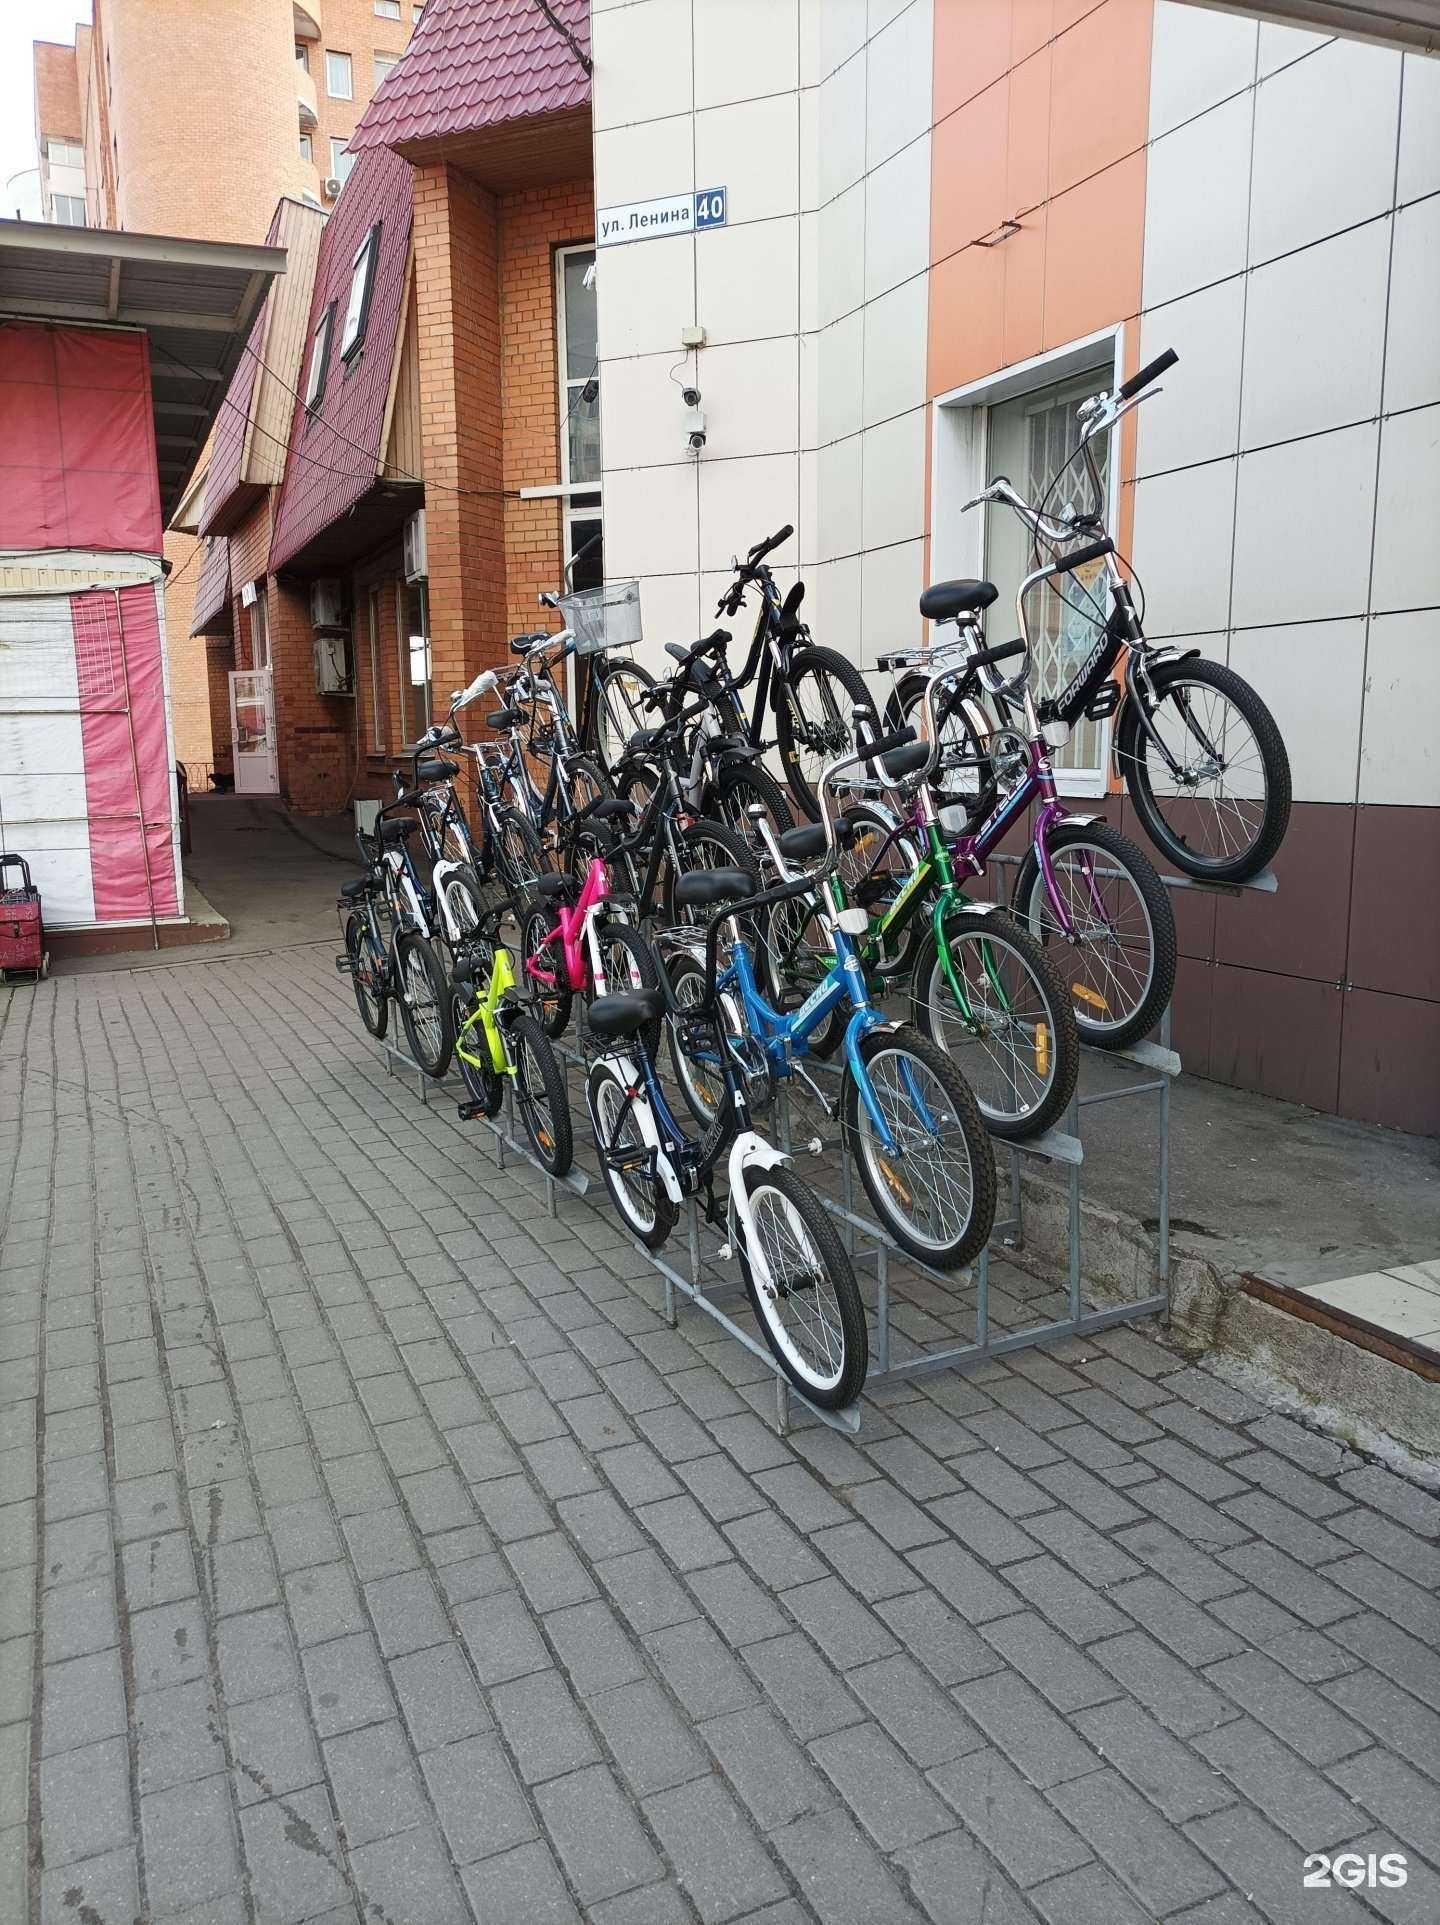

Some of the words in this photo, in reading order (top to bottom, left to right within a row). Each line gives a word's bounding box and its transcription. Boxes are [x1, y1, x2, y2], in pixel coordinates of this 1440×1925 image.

[601, 220, 625, 238] ул.
[628, 207, 690, 230] Ленина
[696, 194, 723, 221] 40
[1057, 631, 1109, 715] FORWARD
